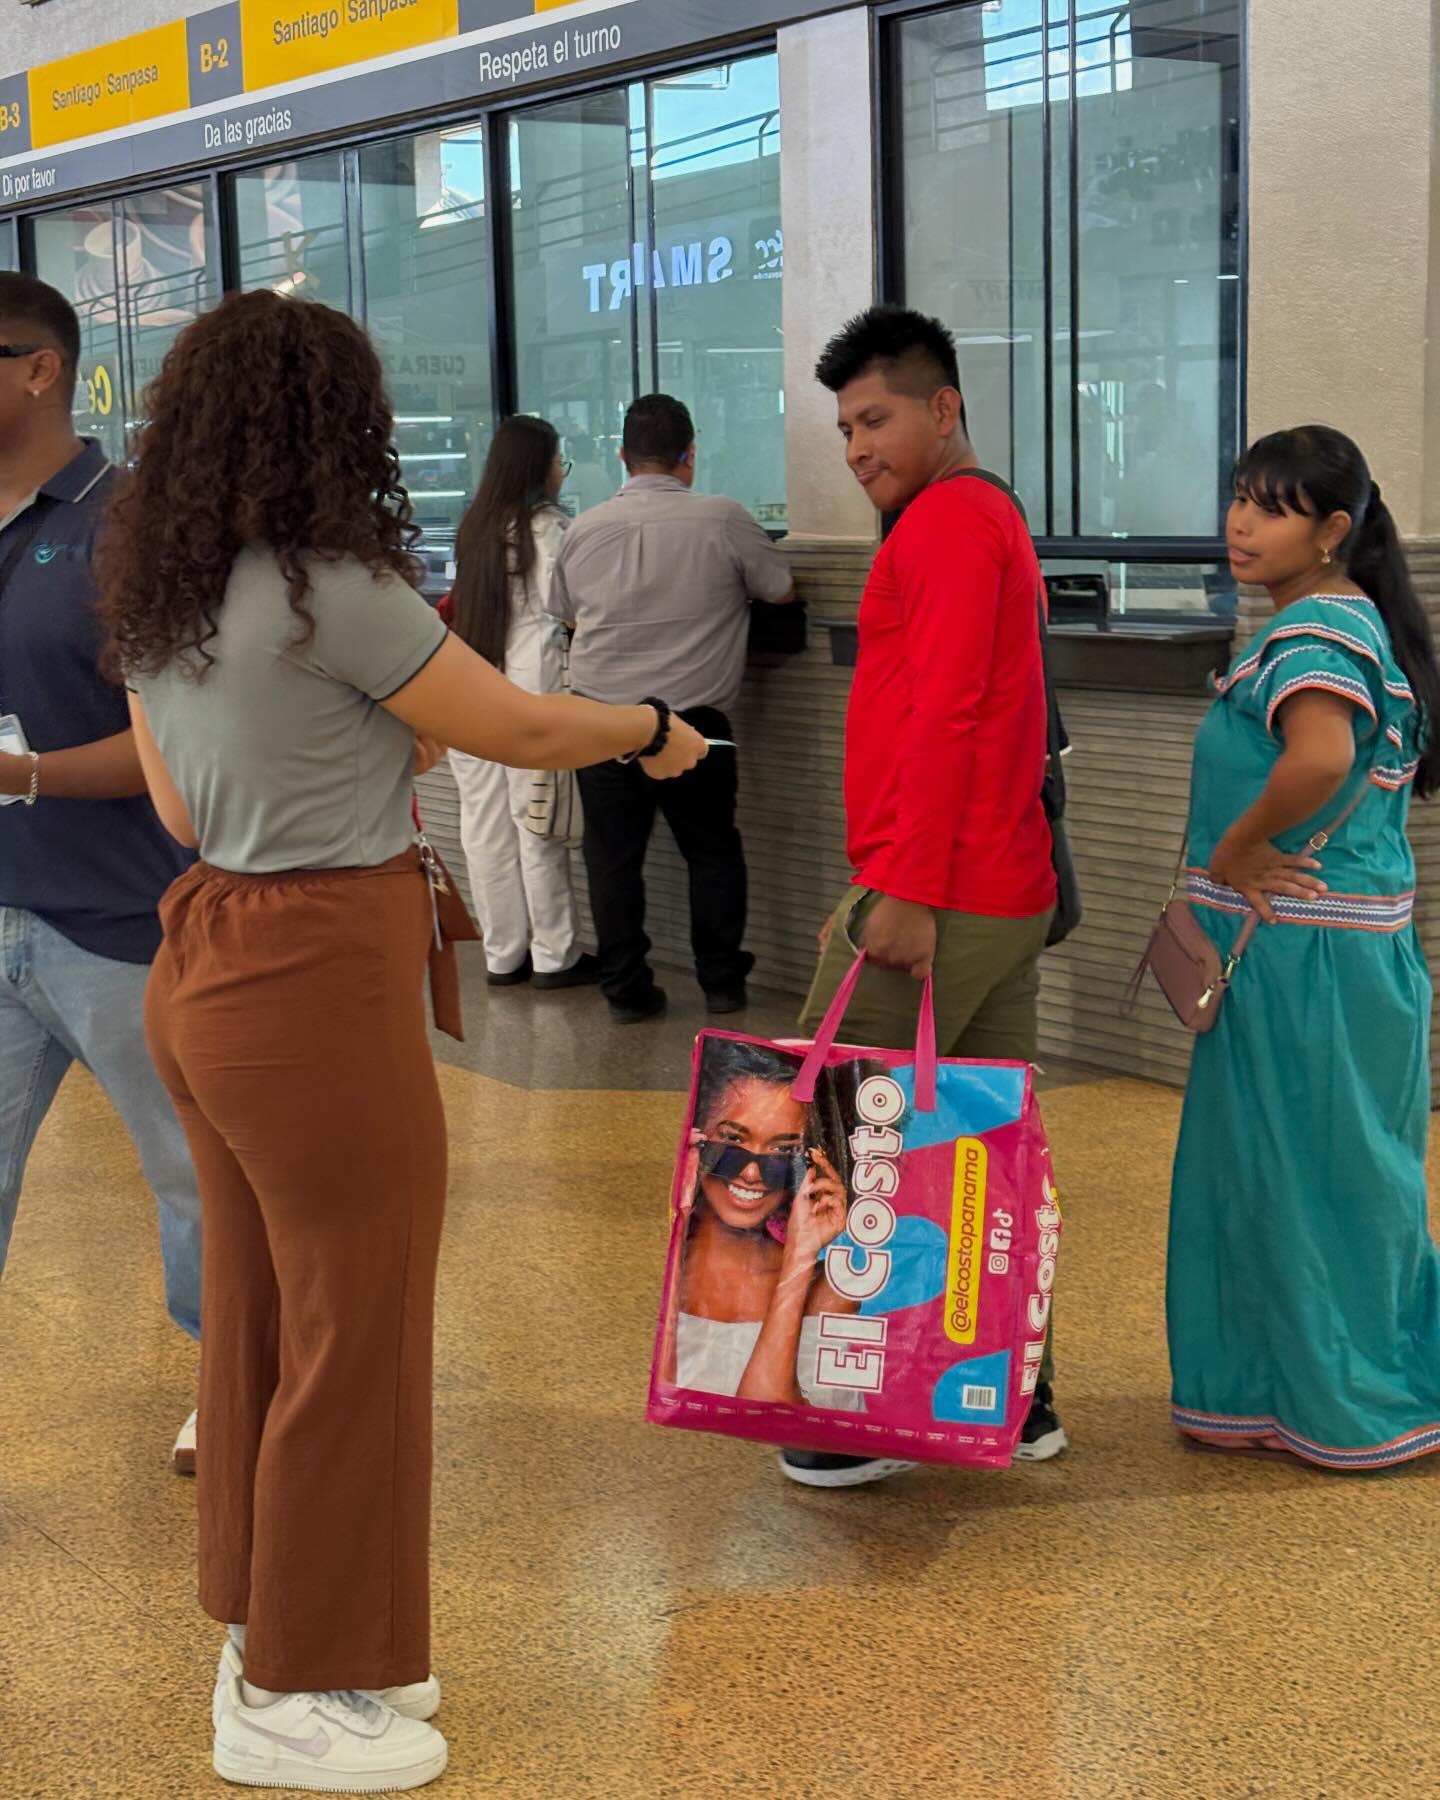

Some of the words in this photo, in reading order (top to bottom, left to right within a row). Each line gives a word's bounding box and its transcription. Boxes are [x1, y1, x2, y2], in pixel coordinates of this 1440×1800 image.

[273, 11, 339, 45] Santiago
[348, 0, 418, 23] Sanpa
[200, 38, 230, 73] B-2
[479, 41, 549, 82] Respeta
[553, 30, 569, 64] el
[573, 24, 622, 59] turno
[52, 82, 101, 111] Santiago
[107, 64, 159, 95] Sanpasa
[0, 102, 20, 131] B-3
[204, 123, 222, 149] Da
[224, 119, 243, 144] las
[245, 107, 292, 145] gracias
[2, 173, 13, 197] Di
[14, 178, 30, 199] por
[32, 167, 56, 191] favor
[824, 1075, 906, 1301] Costo
[951, 1147, 979, 1333] @elcostopanama
[815, 1312, 889, 1393] El
